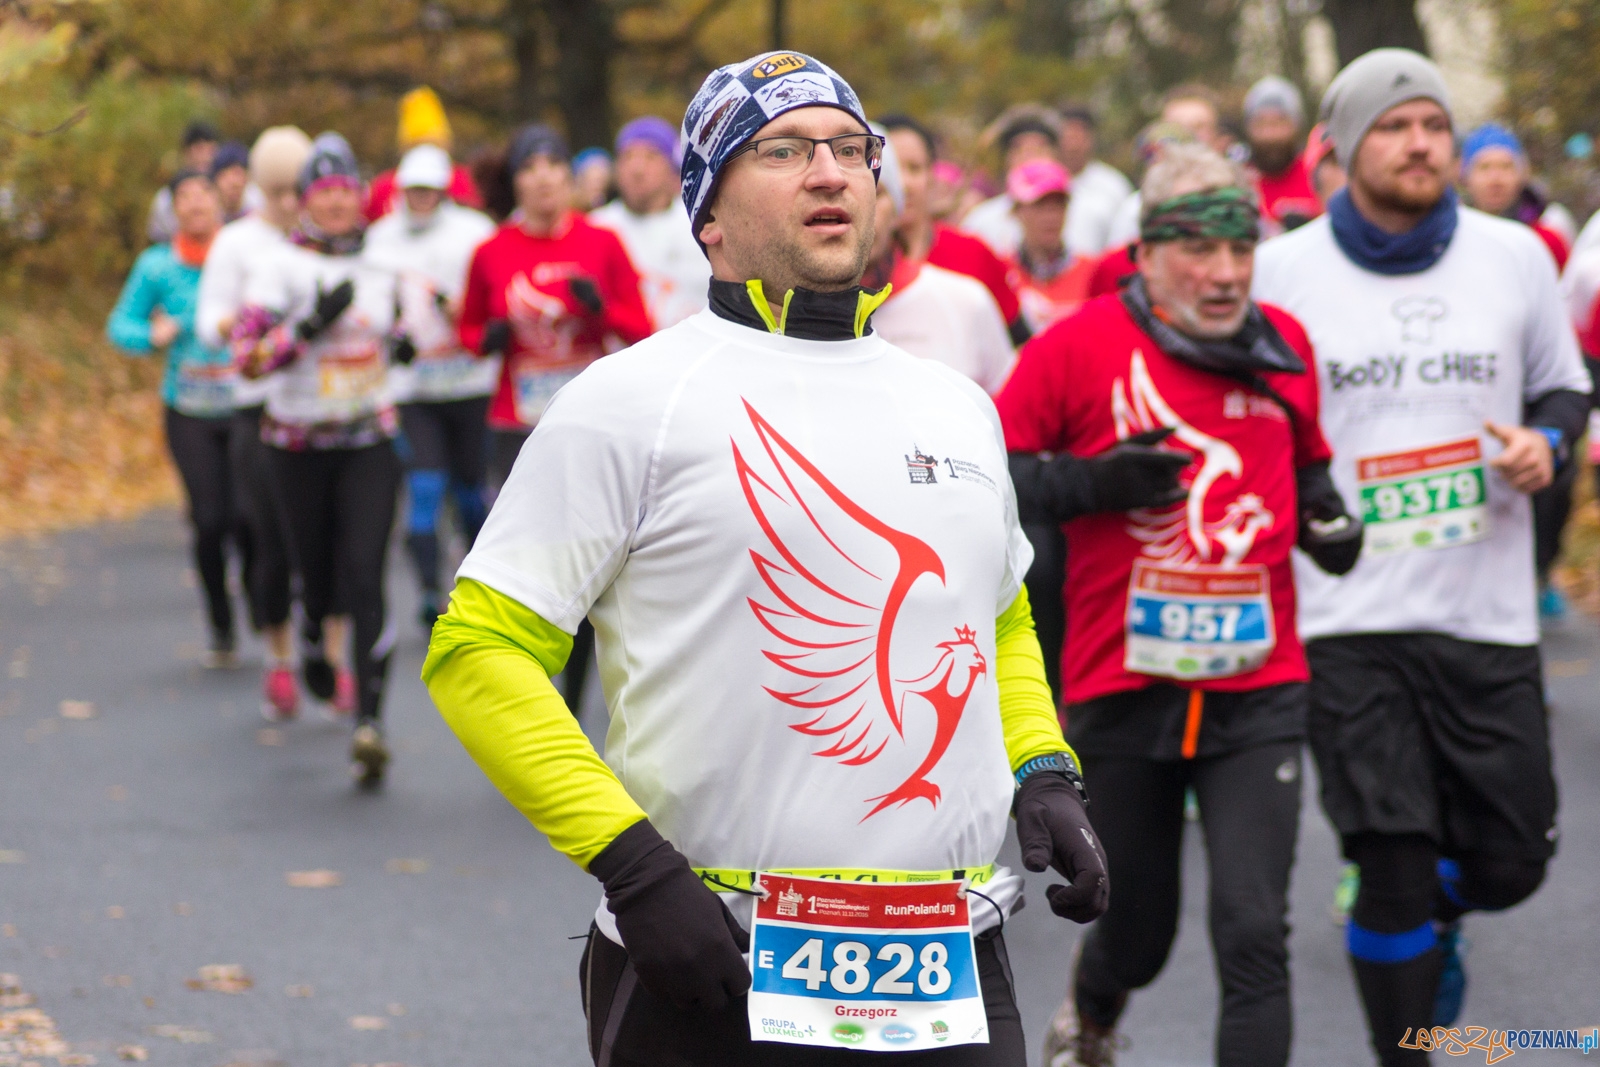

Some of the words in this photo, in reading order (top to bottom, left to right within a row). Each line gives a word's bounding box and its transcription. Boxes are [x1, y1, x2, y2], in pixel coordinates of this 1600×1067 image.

[757, 56, 803, 77] Buff
[1326, 352, 1407, 391] BODY
[944, 457, 959, 479] 1
[1374, 471, 1480, 520] 9379
[1159, 603, 1243, 640] 957
[807, 895, 818, 914] 1
[884, 902, 956, 916] RunPoland.org
[758, 949, 775, 969] E
[781, 938, 952, 995] 4828
[835, 1005, 898, 1019] Grzegorz
[761, 1018, 797, 1030] GRUPA
[763, 1026, 805, 1039] LUXMED
